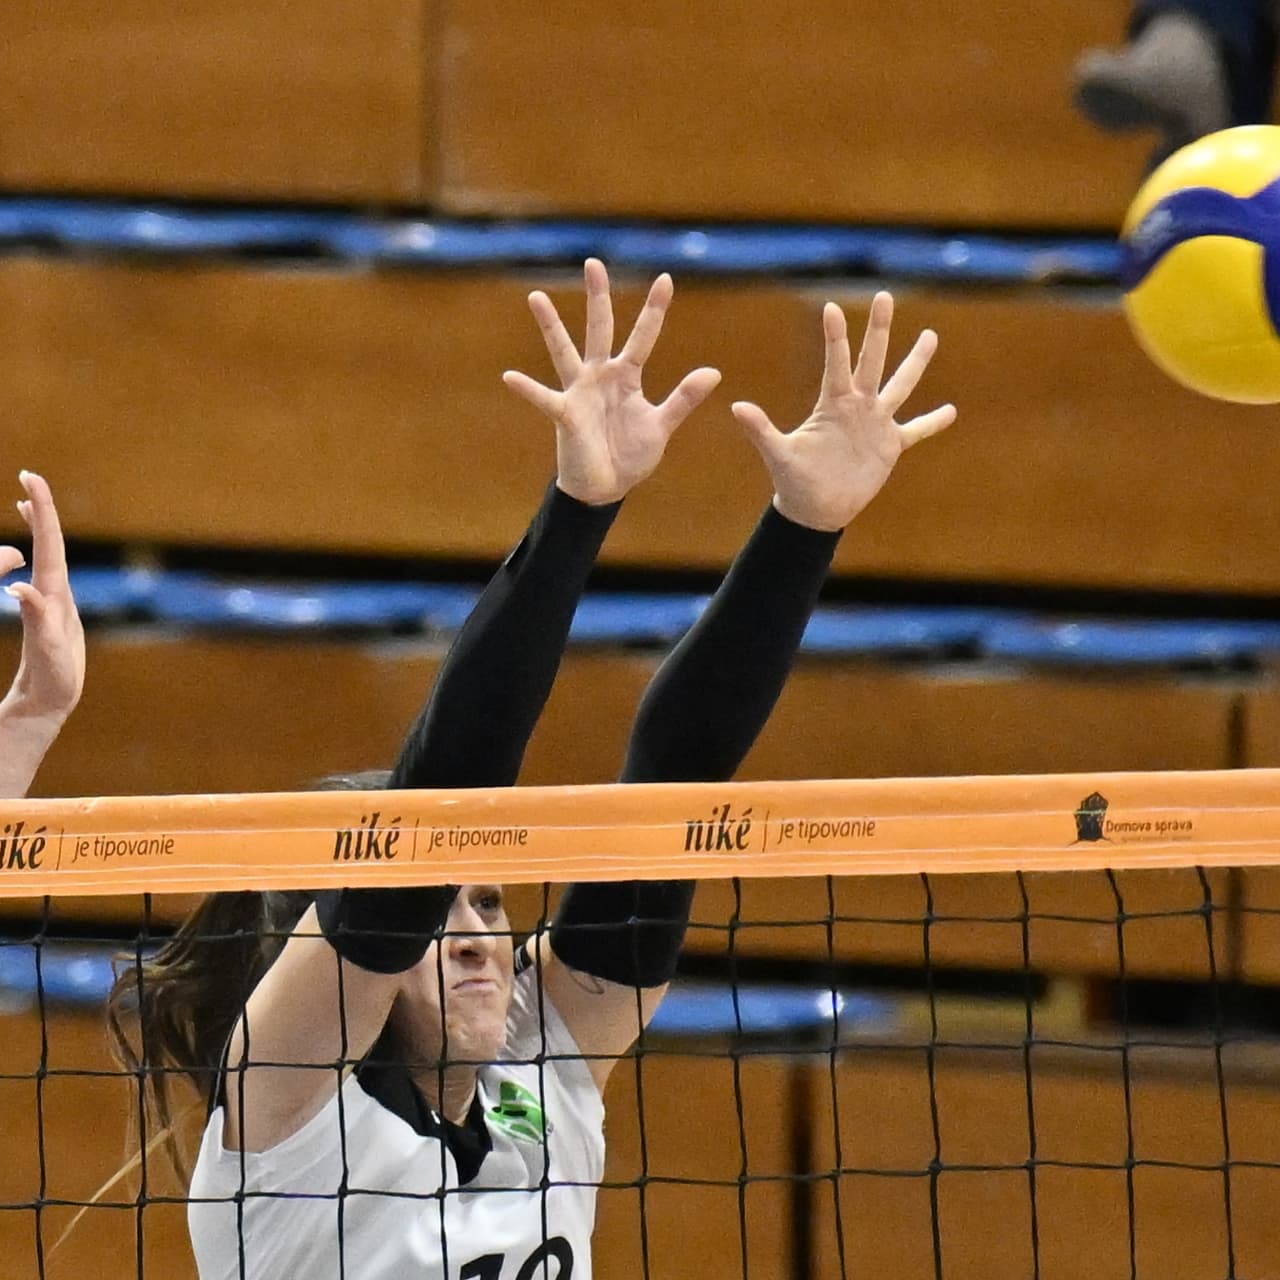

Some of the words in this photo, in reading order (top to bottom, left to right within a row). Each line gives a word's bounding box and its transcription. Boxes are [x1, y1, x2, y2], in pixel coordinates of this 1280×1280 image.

[332, 811, 402, 861] niké
[427, 826, 445, 853] je
[448, 825, 529, 852] tipovanie
[683, 803, 753, 852] niké
[777, 817, 795, 845] je
[798, 815, 876, 844] tipovanie
[71, 836, 89, 864] je
[93, 834, 175, 862] tipovanie
